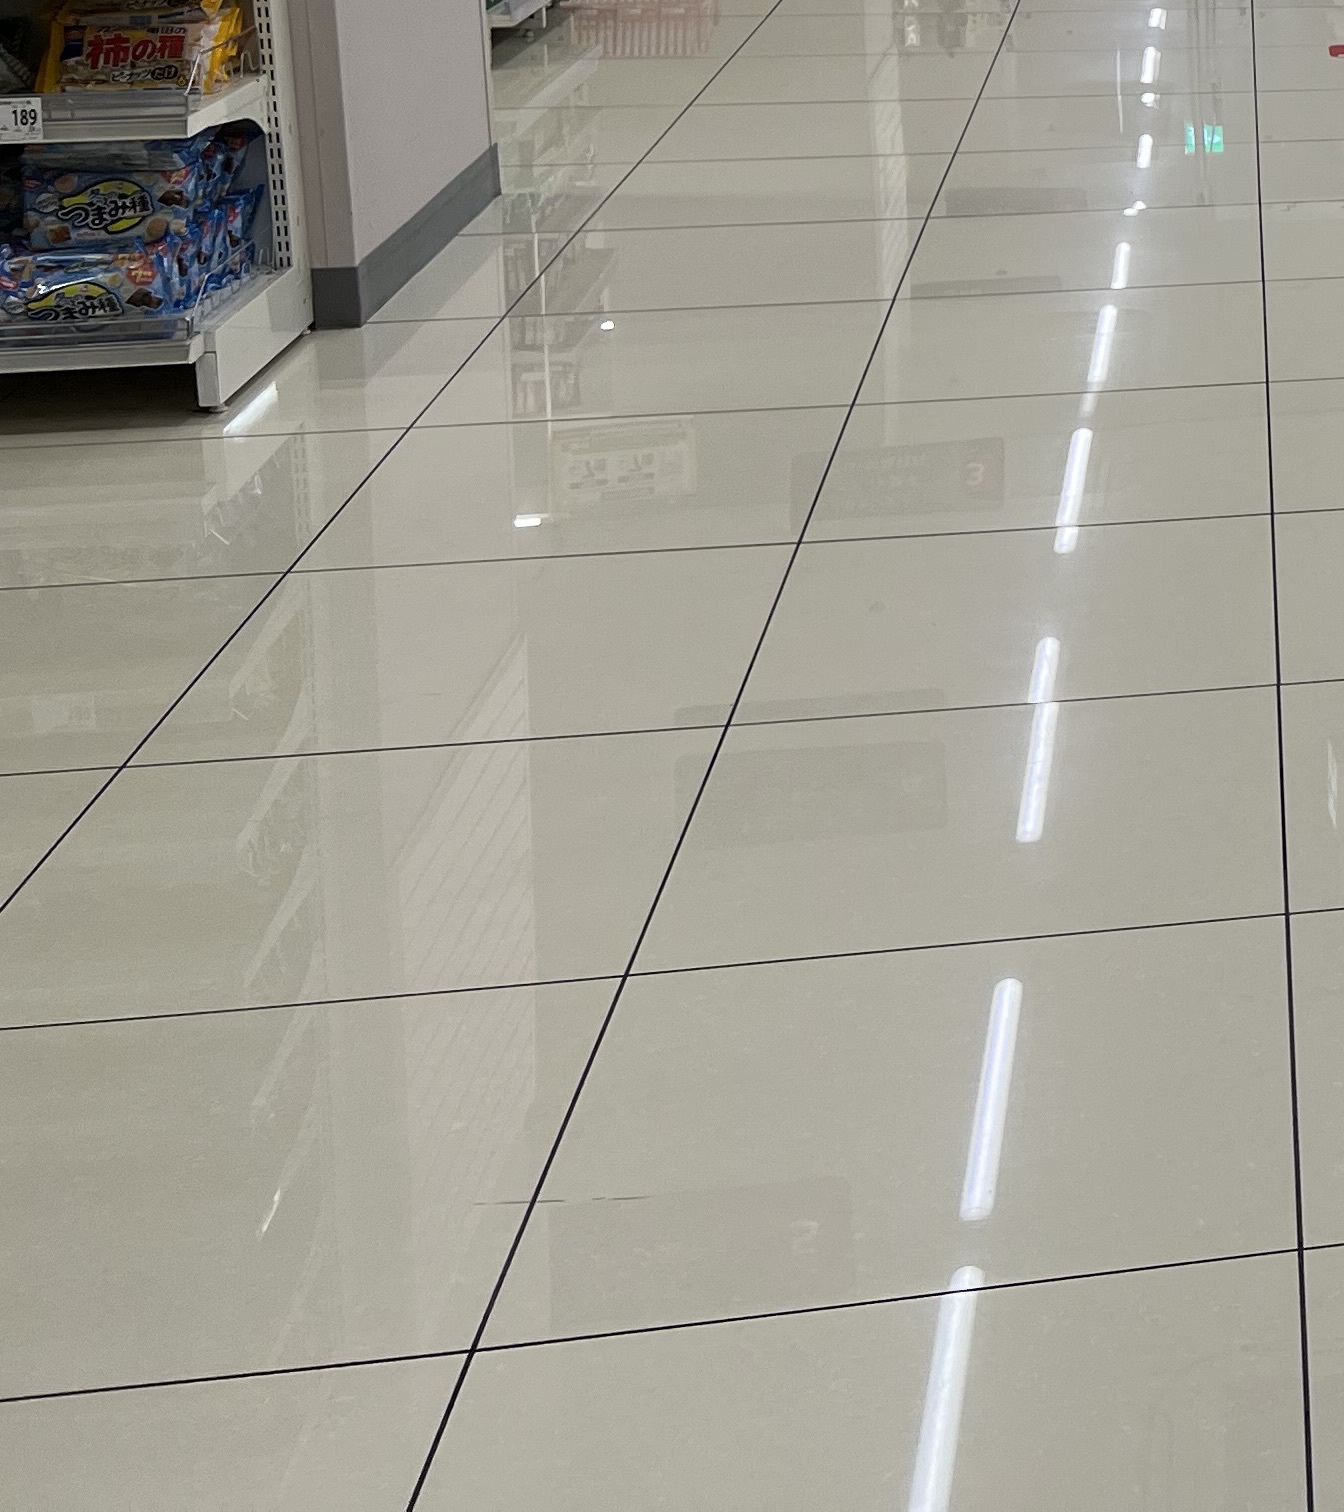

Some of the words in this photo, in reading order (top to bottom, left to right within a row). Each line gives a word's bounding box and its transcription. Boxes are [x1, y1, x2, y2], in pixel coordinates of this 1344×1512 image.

[86, 33, 186, 70] 柿の種
[11, 108, 38, 127] 189
[57, 190, 152, 230] つまみ種
